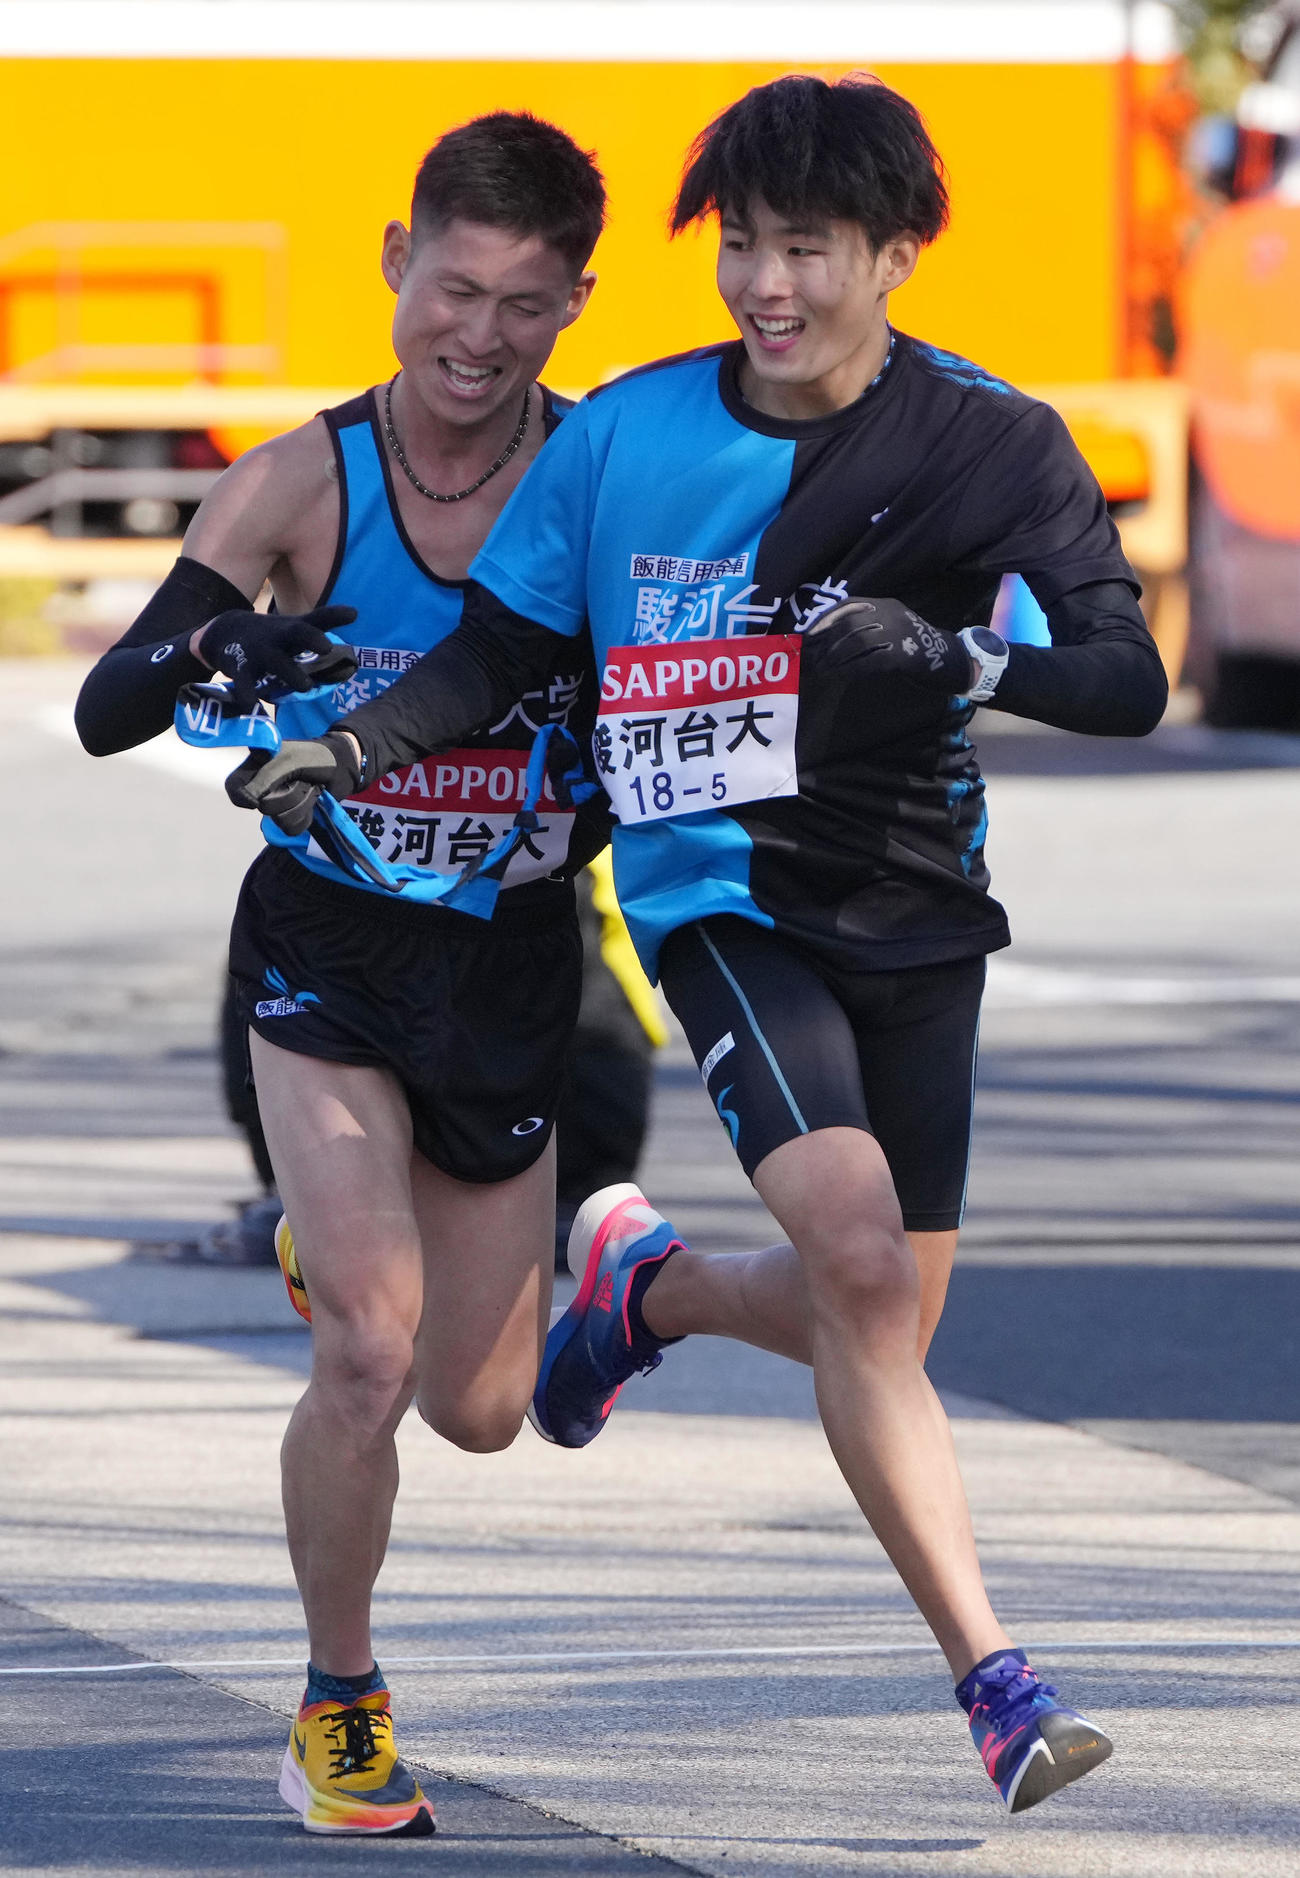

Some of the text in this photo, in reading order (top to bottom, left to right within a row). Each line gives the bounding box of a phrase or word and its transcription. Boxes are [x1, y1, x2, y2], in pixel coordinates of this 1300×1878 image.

[632, 576, 849, 646] 駿河台学
[601, 651, 790, 702] SAPPORO
[378, 762, 557, 802] SAPPO
